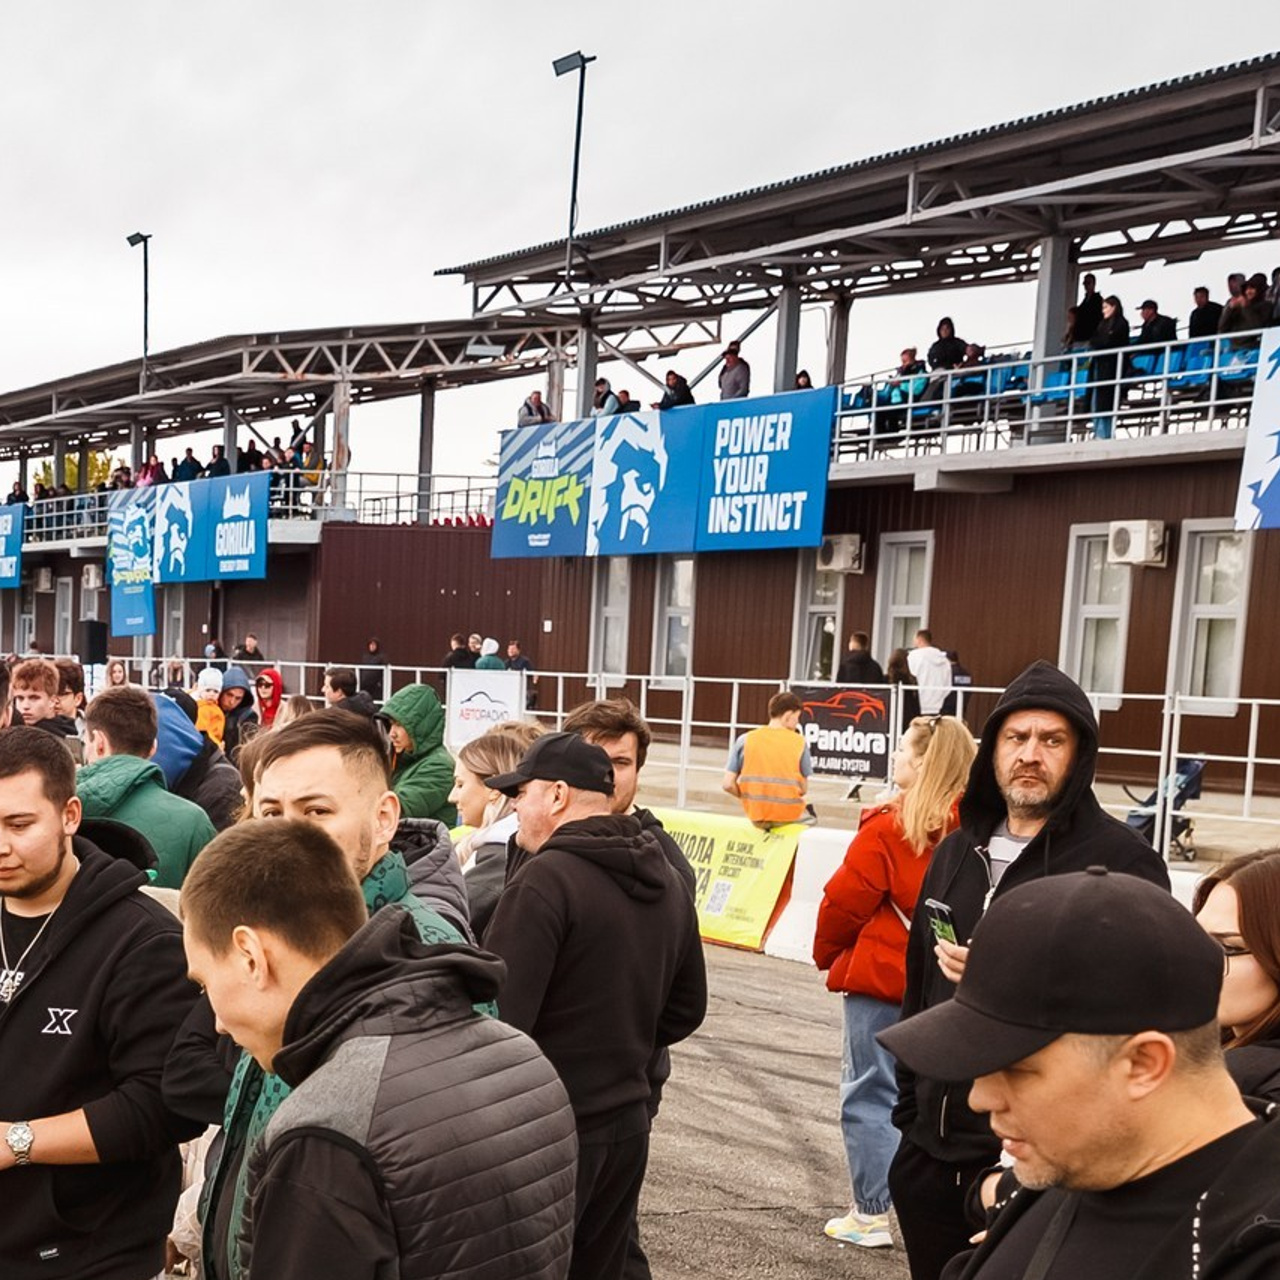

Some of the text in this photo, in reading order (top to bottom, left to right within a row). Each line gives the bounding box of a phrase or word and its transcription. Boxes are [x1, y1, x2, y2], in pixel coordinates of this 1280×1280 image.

[714, 412, 793, 457] POWER
[713, 454, 769, 495] YOUR
[707, 491, 808, 534] INSTINCT
[216, 520, 256, 557] GORILLA
[804, 723, 886, 755] Pandora
[842, 757, 870, 772] SYSTEM
